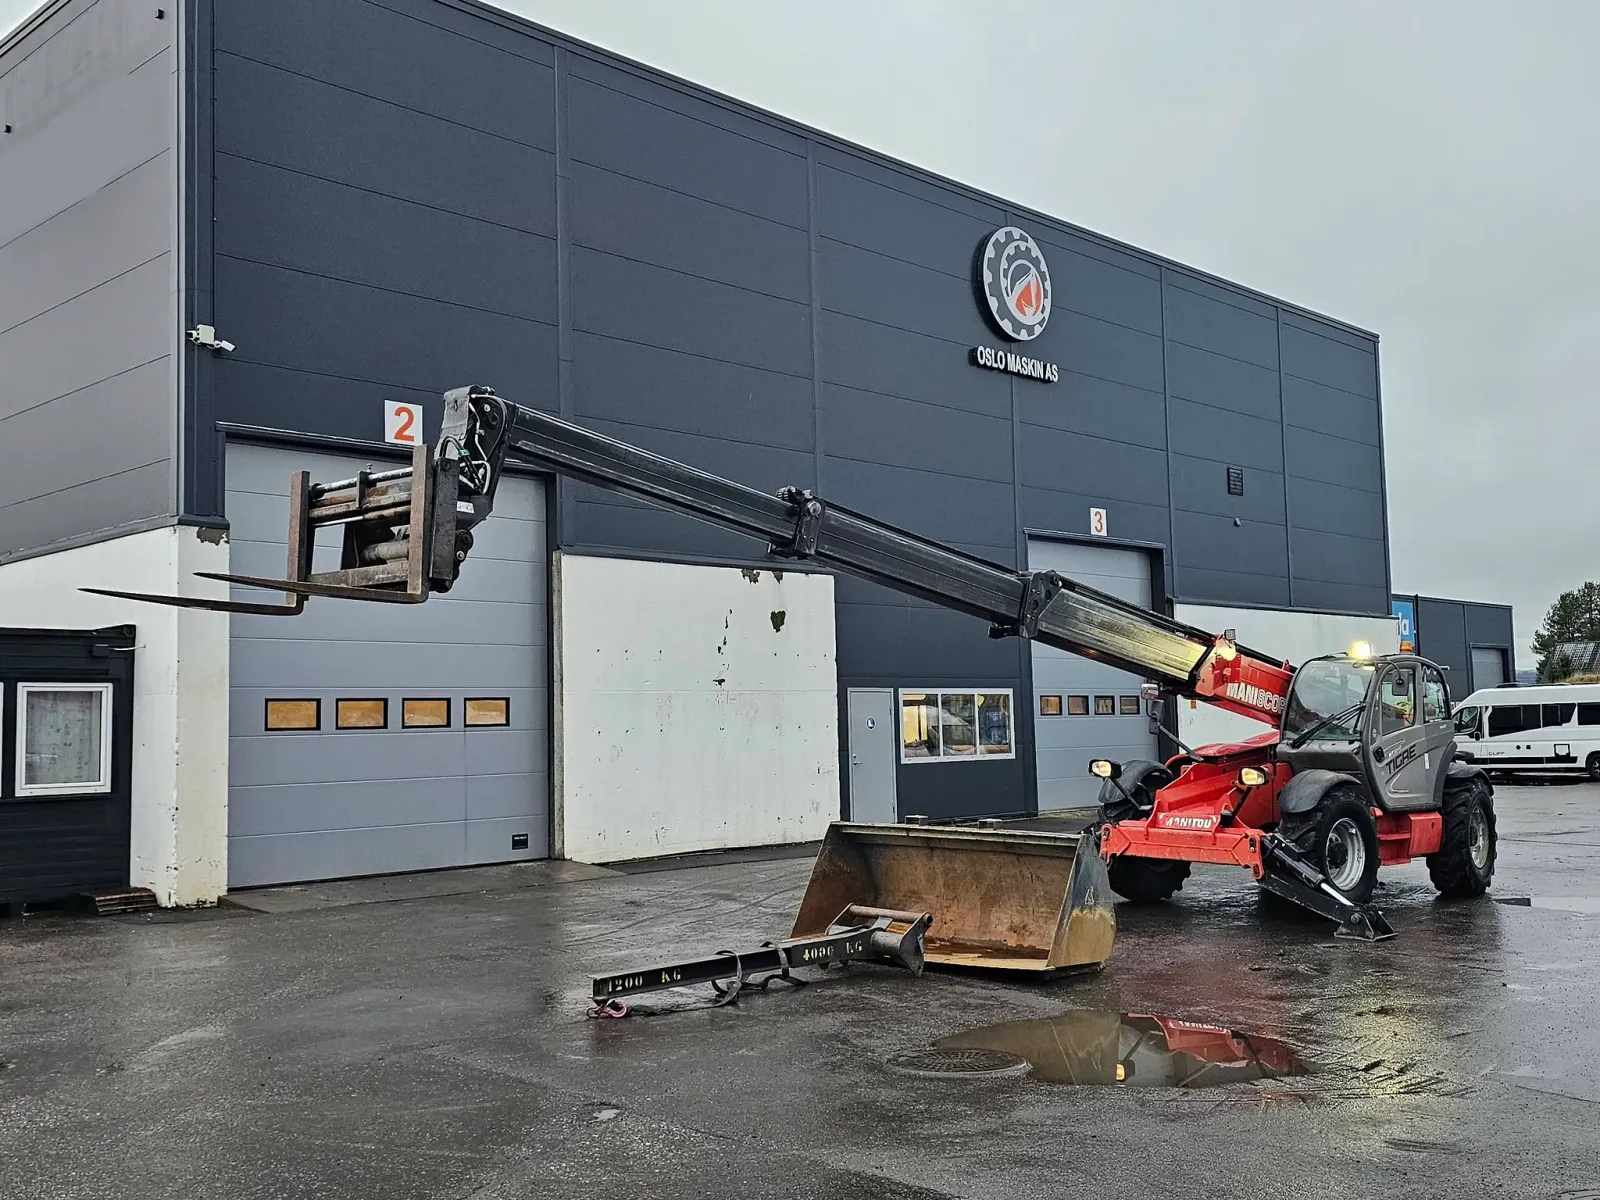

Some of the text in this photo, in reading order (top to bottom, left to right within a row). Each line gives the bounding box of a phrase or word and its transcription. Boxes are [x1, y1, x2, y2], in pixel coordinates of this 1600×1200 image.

[977, 345, 1059, 383] OSLO MASKIN AS
[393, 406, 415, 441] 2
[1094, 510, 1104, 533] 3
[1385, 744, 1417, 775] TIGRE
[1165, 816, 1212, 829] MANITOU
[802, 940, 863, 961] 4000 KG
[608, 968, 681, 992] 1200 KG
